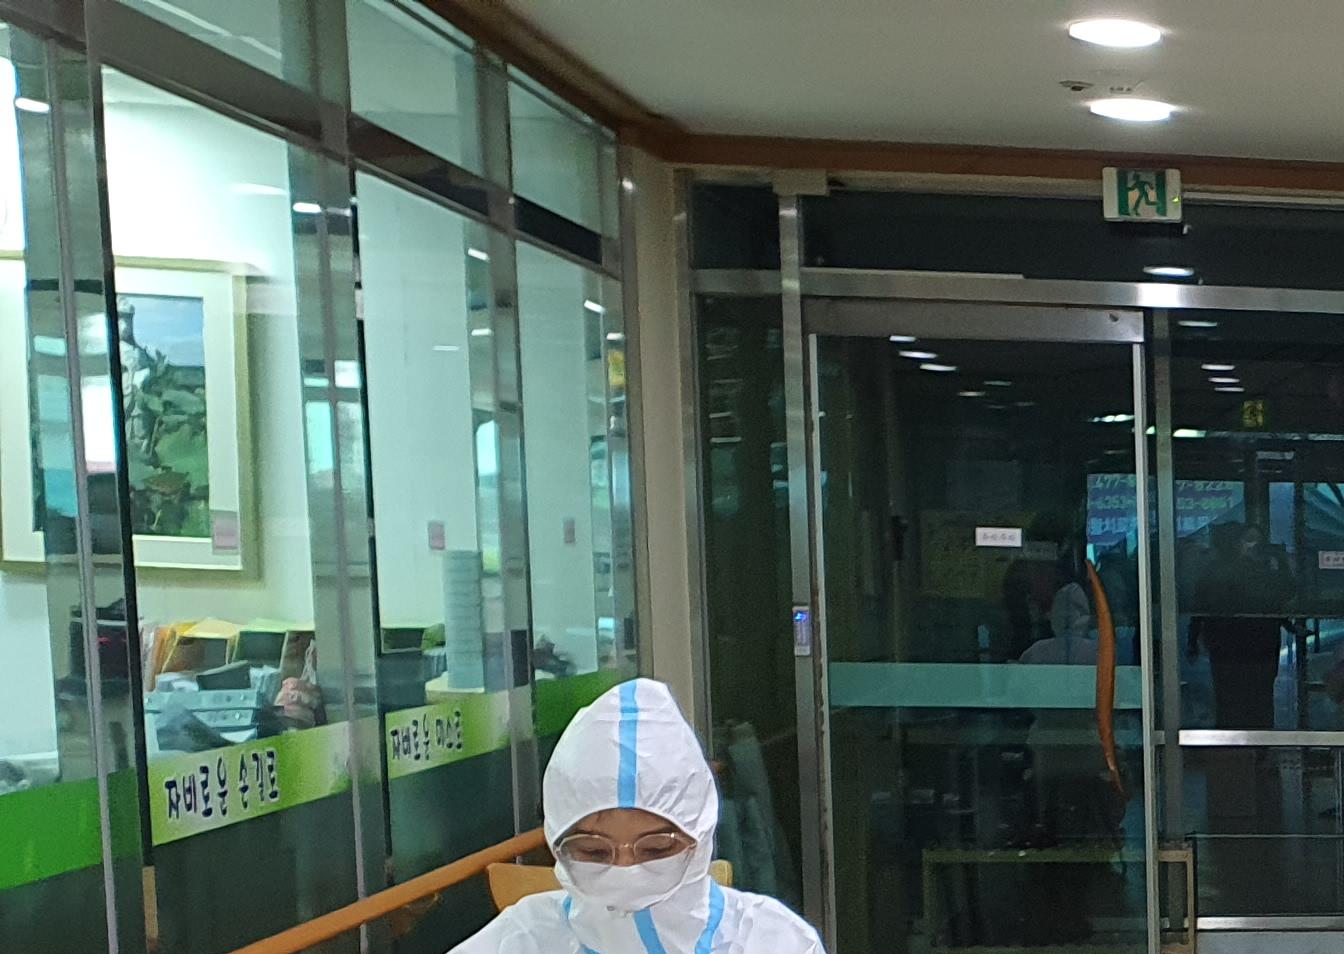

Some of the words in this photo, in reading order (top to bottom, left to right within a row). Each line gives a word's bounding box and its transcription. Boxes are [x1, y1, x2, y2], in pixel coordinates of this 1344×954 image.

[390, 713, 430, 760] 자비로운
[164, 757, 228, 819] 자비로운
[239, 750, 279, 809] 손길로
